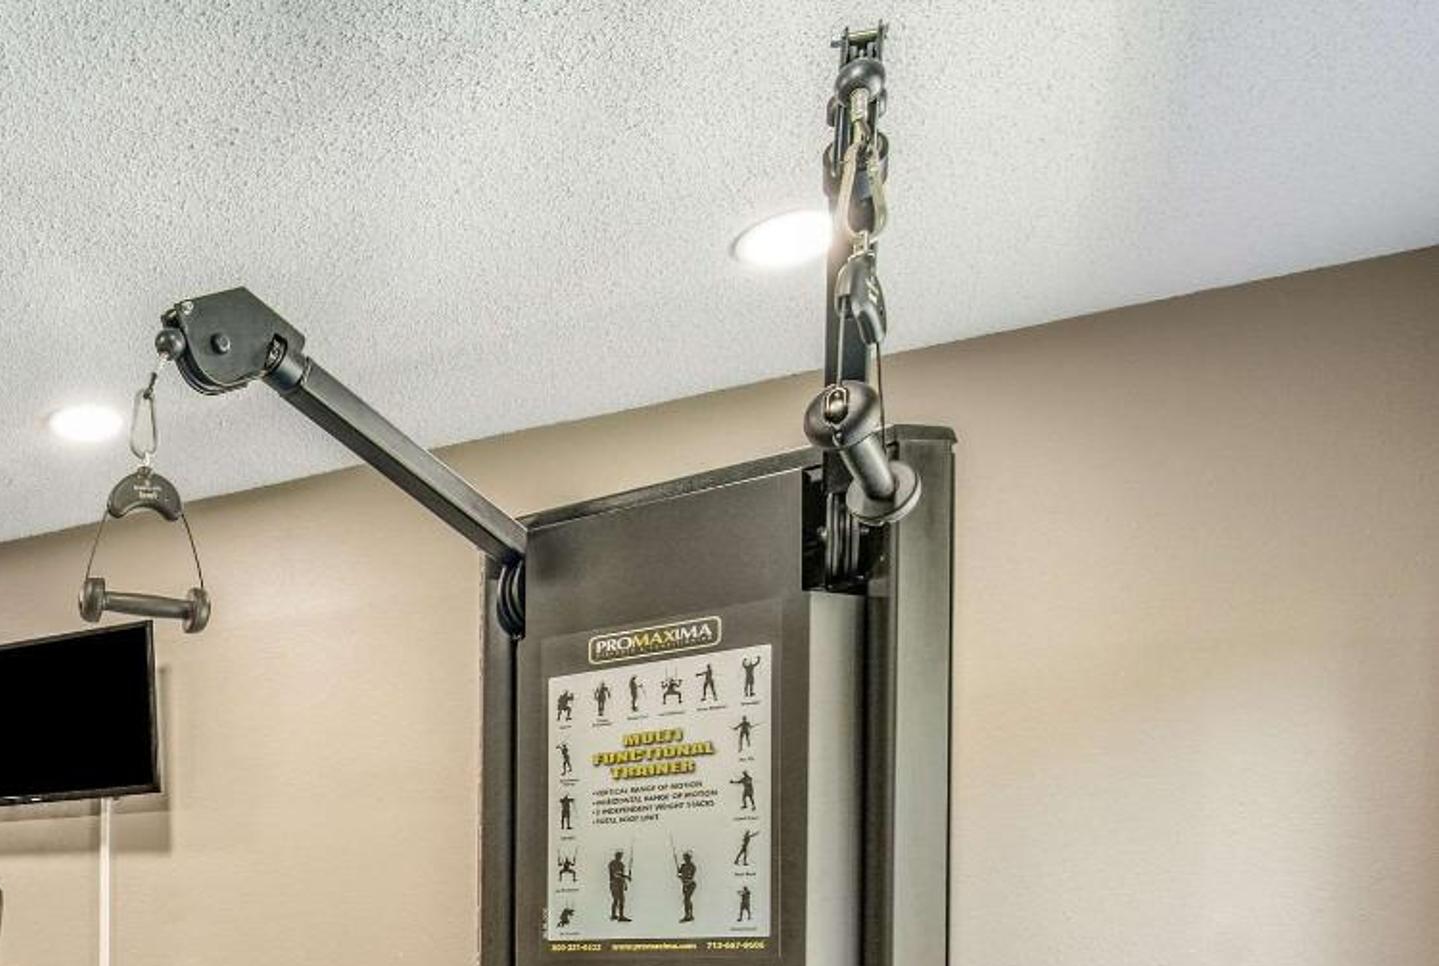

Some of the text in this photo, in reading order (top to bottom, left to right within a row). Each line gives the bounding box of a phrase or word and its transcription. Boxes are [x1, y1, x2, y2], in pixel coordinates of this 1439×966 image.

[595, 623, 713, 654] PROMAXIMA
[623, 729, 683, 747] MULTI
[592, 741, 715, 767] FUNCTIONAL
[610, 760, 696, 780] TRAINER
